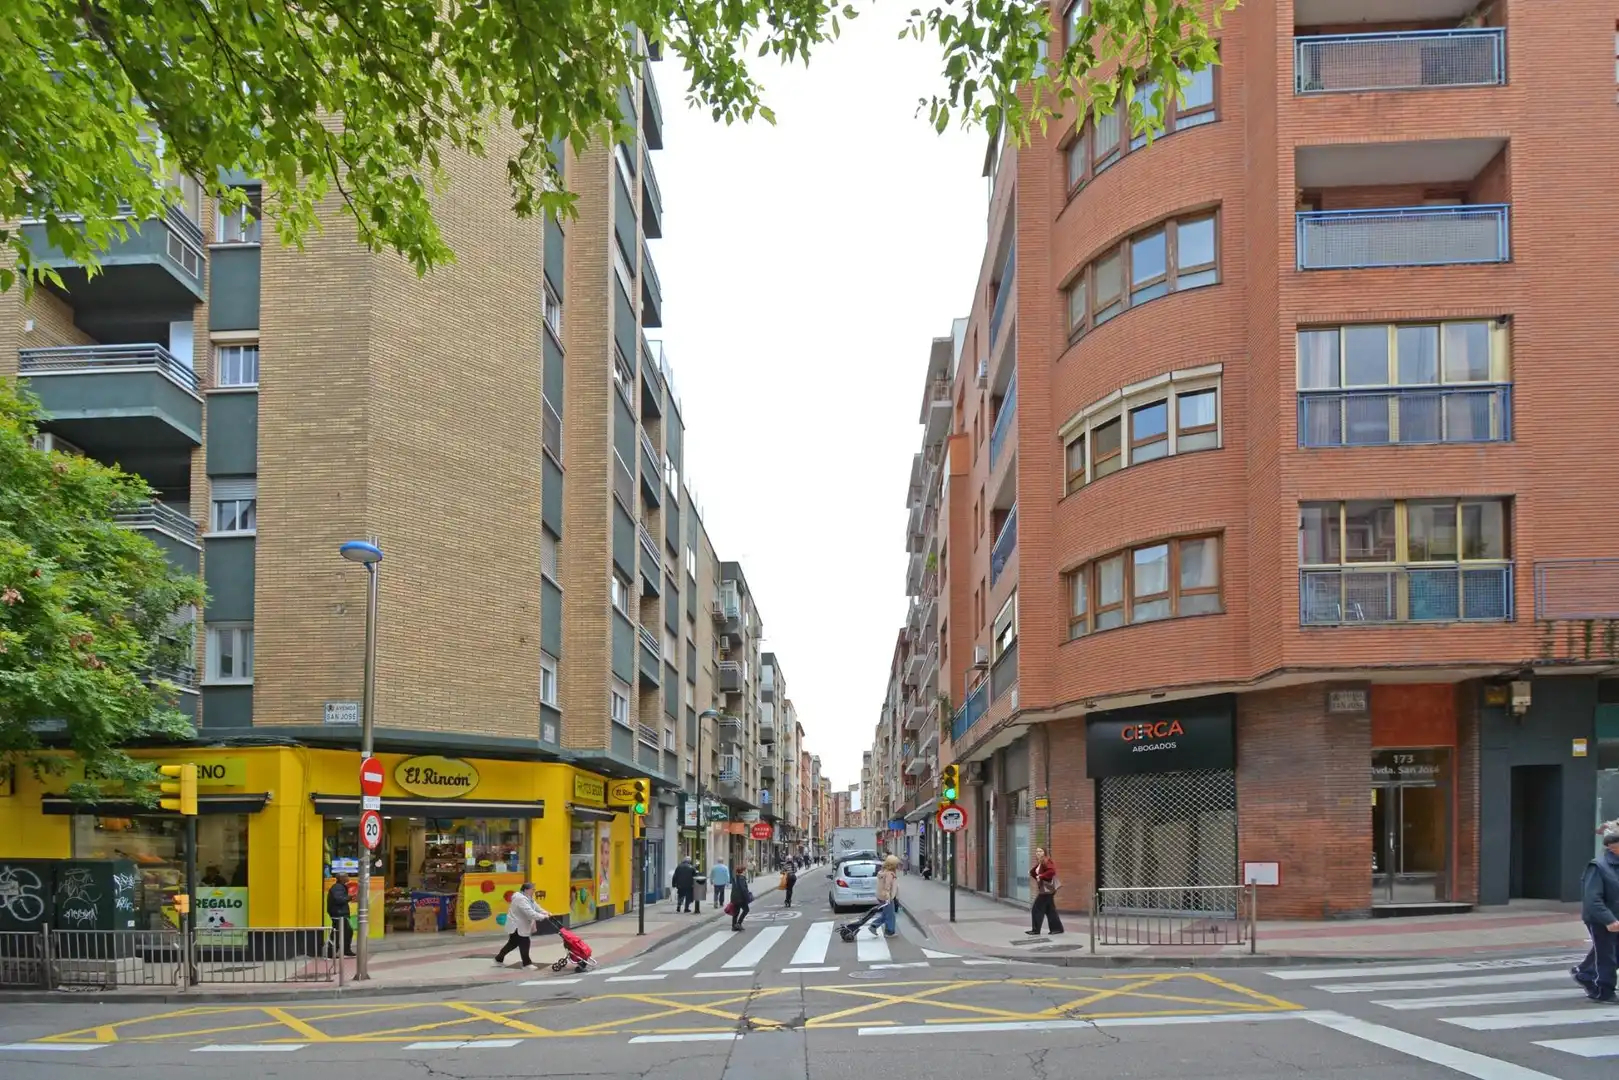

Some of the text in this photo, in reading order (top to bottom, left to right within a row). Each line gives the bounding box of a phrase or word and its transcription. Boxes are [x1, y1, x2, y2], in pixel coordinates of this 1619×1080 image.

[1121, 719, 1184, 741] CERCA
[1132, 741, 1177, 752] ABOGADOS
[1393, 754, 1414, 764] 173
[1398, 766, 1416, 774] San
[404, 766, 470, 786] El Rincón
[366, 823, 378, 837] 20
[195, 898, 243, 909] REGALO
